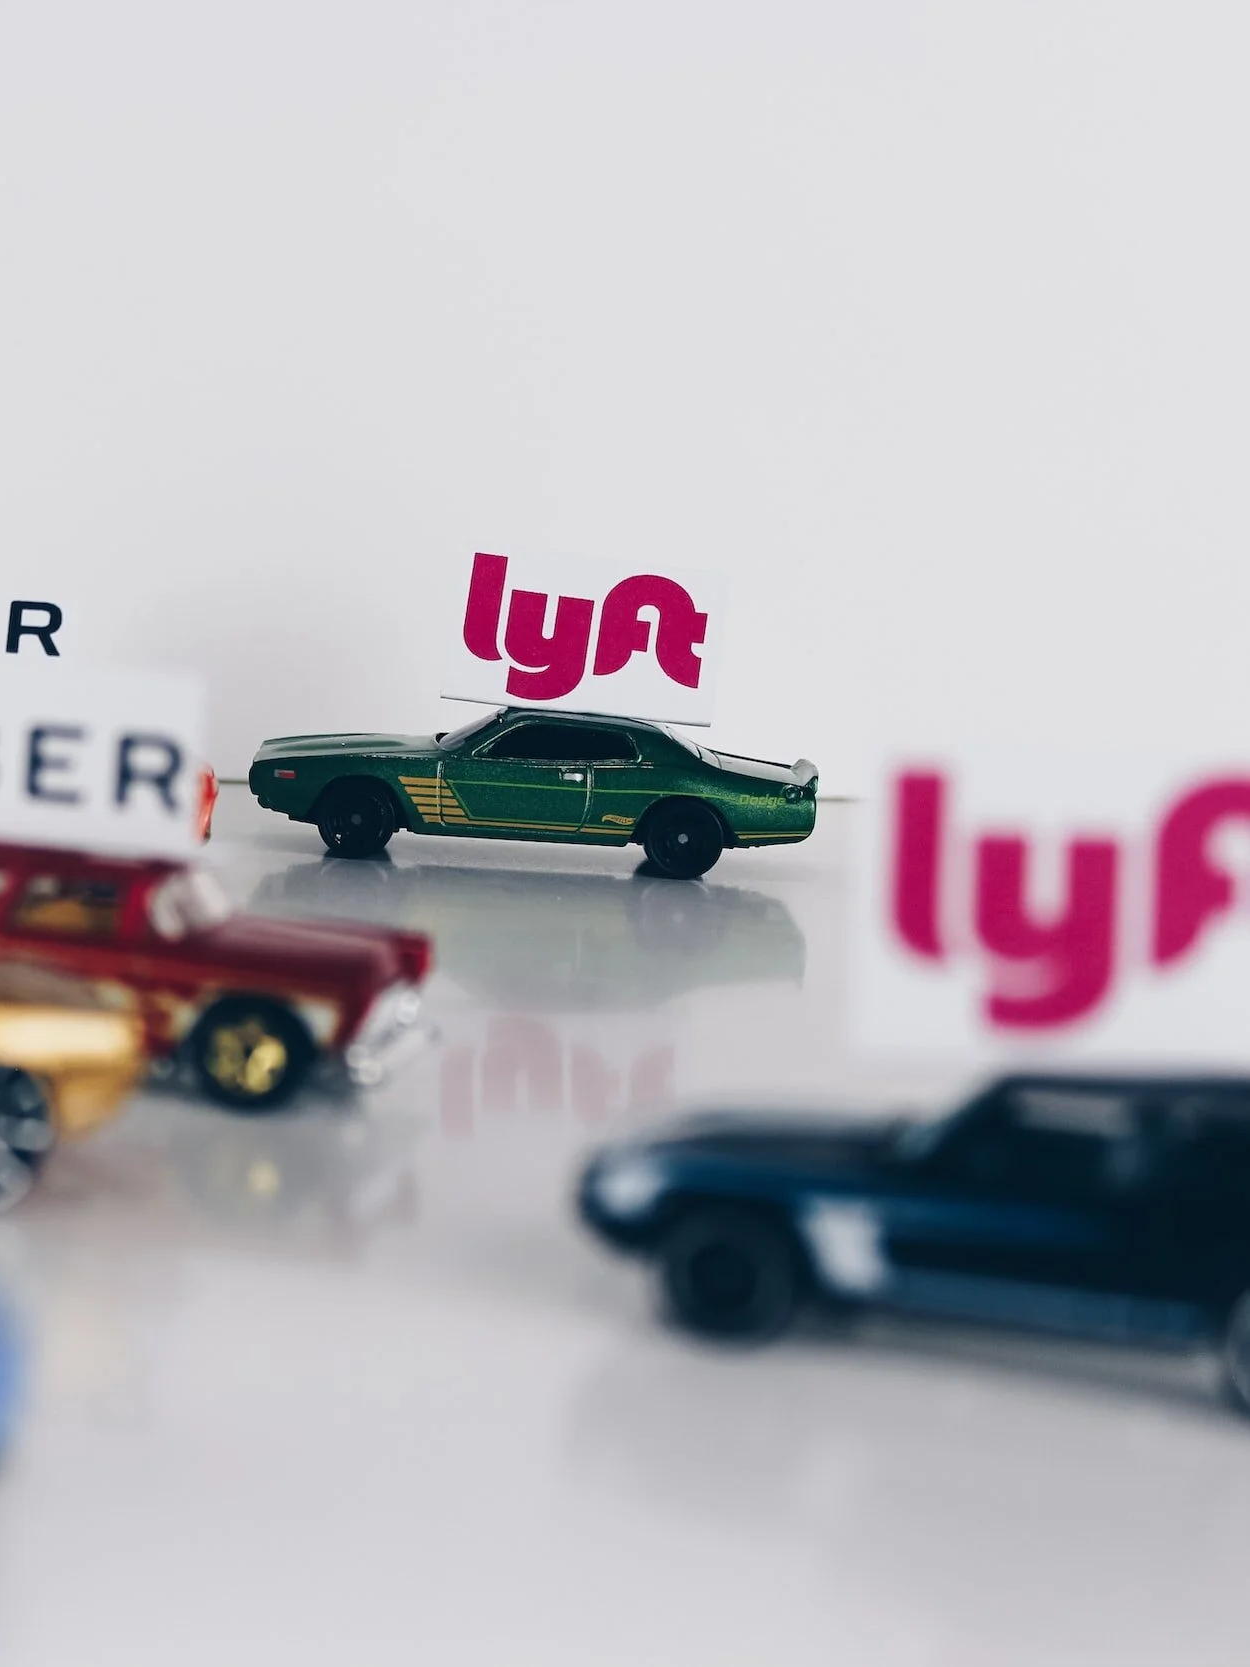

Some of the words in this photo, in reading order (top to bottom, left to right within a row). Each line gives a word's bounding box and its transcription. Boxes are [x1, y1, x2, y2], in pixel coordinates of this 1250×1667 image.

[462, 552, 708, 701] lyft
[739, 793, 787, 809] Dodge
[890, 769, 1250, 1032] lyf
